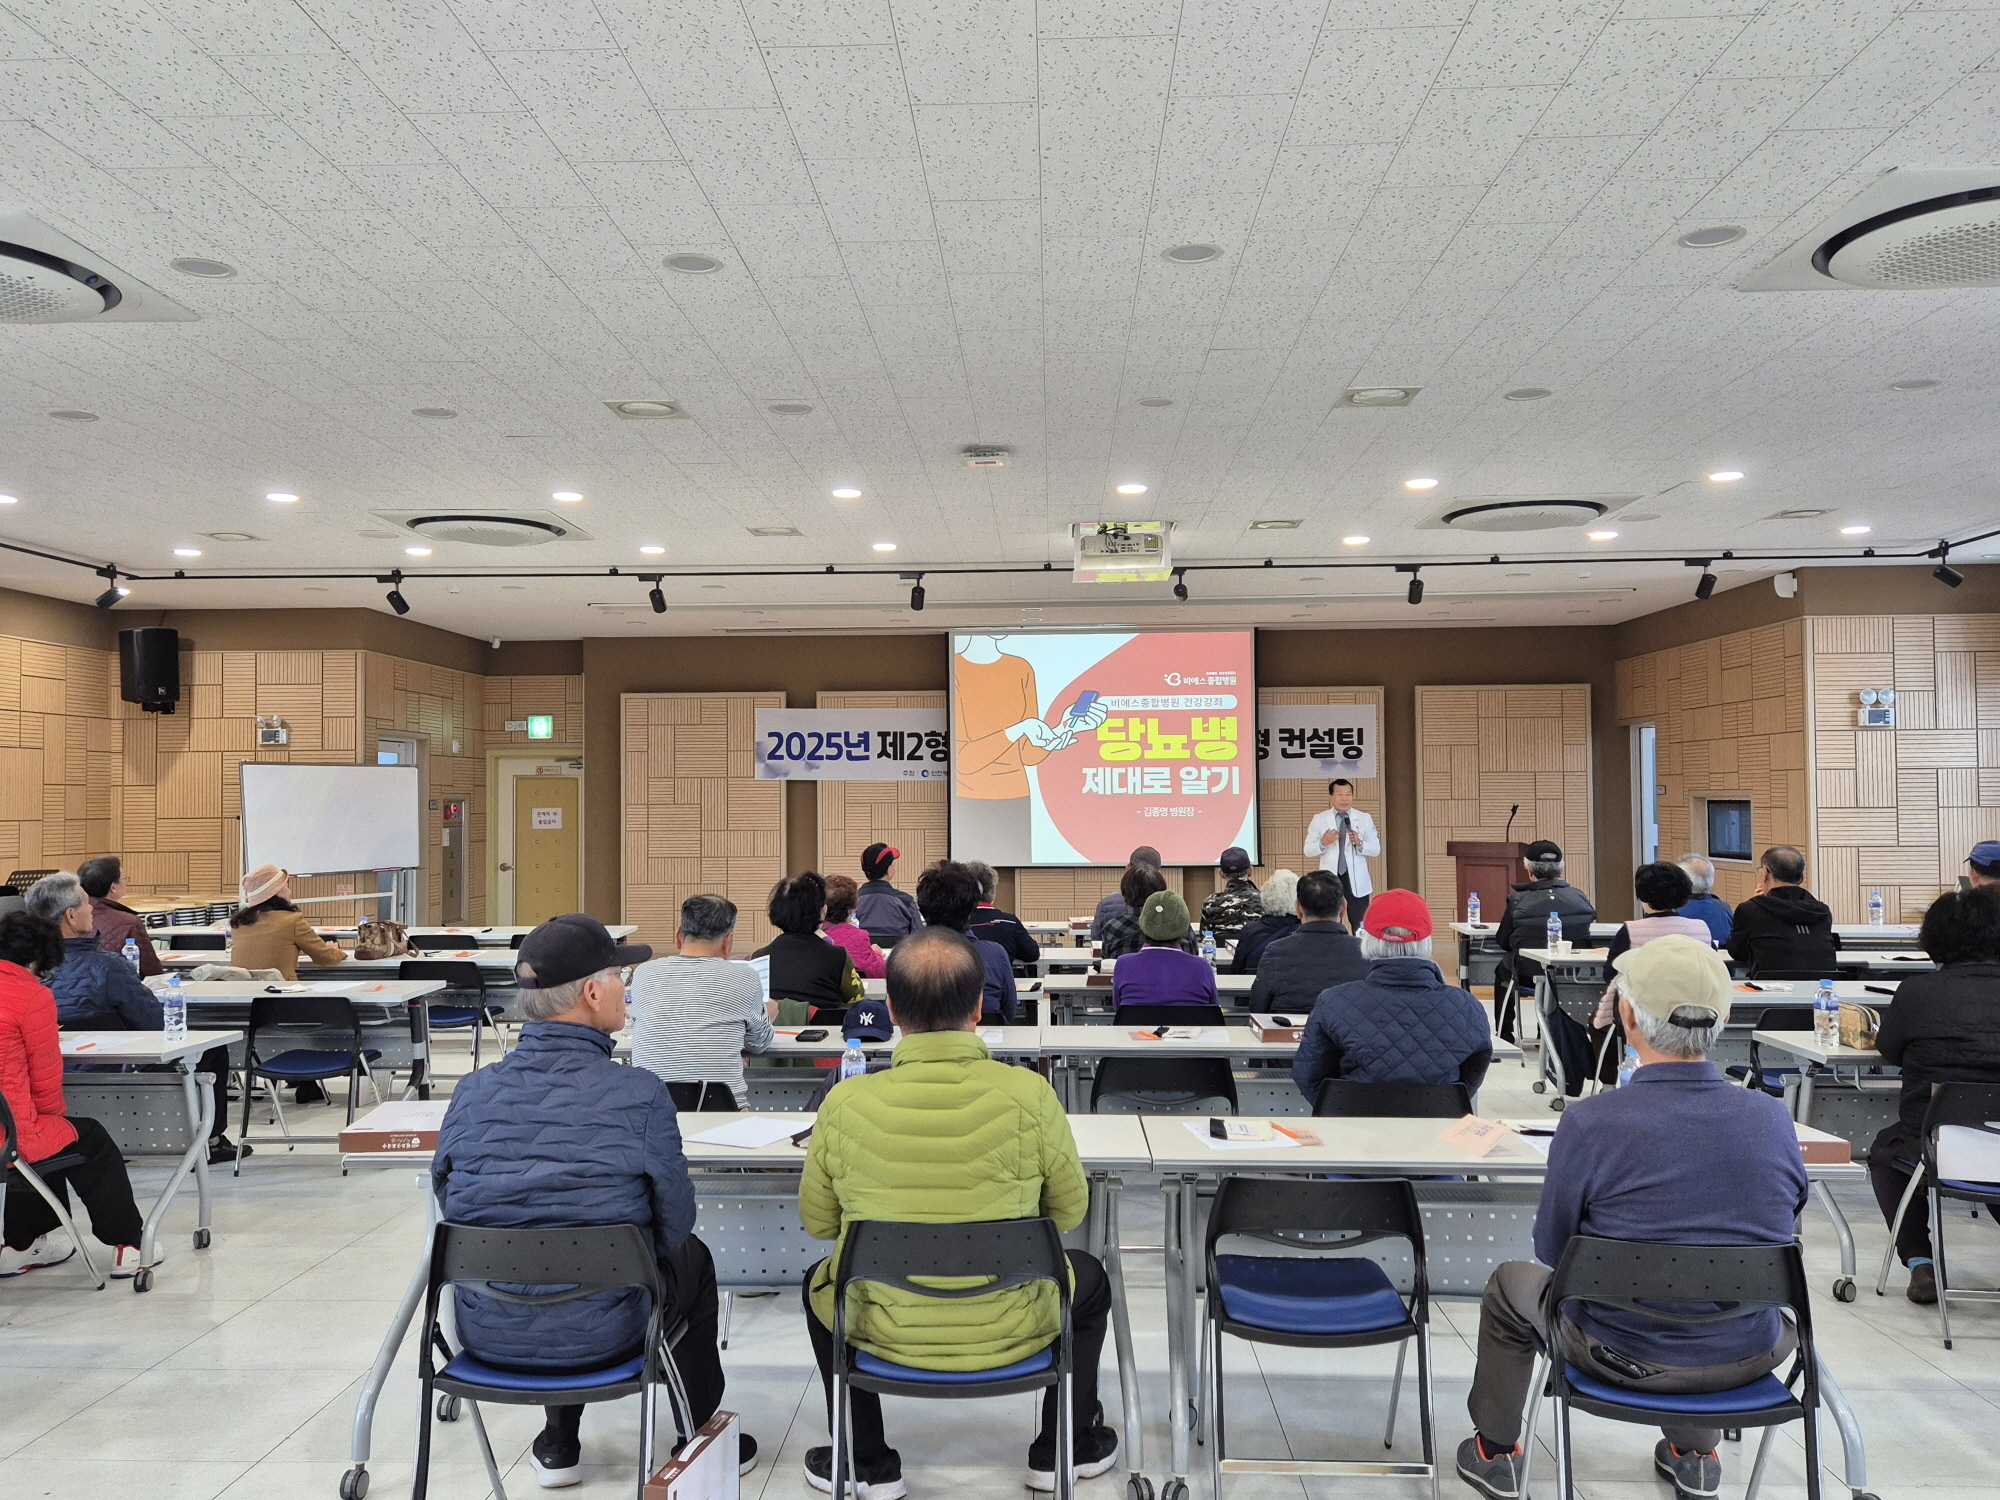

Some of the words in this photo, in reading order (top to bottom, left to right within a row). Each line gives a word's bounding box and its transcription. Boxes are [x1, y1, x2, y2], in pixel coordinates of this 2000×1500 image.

[1183, 676, 1237, 686] 비에스종합병원
[1111, 698, 1180, 708] 비에스종합병원
[1184, 697, 1223, 707] 건강강좌
[767, 731, 870, 762] 2025년
[1097, 717, 1238, 761] 당뇨병
[1278, 727, 1364, 759] 컨설팅
[1082, 766, 1173, 795] 제대로
[1179, 766, 1240, 795] 알기
[1143, 806, 1169, 817] 김종영
[1169, 806, 1195, 817] 병원장
[859, 1011, 875, 1026] NY
